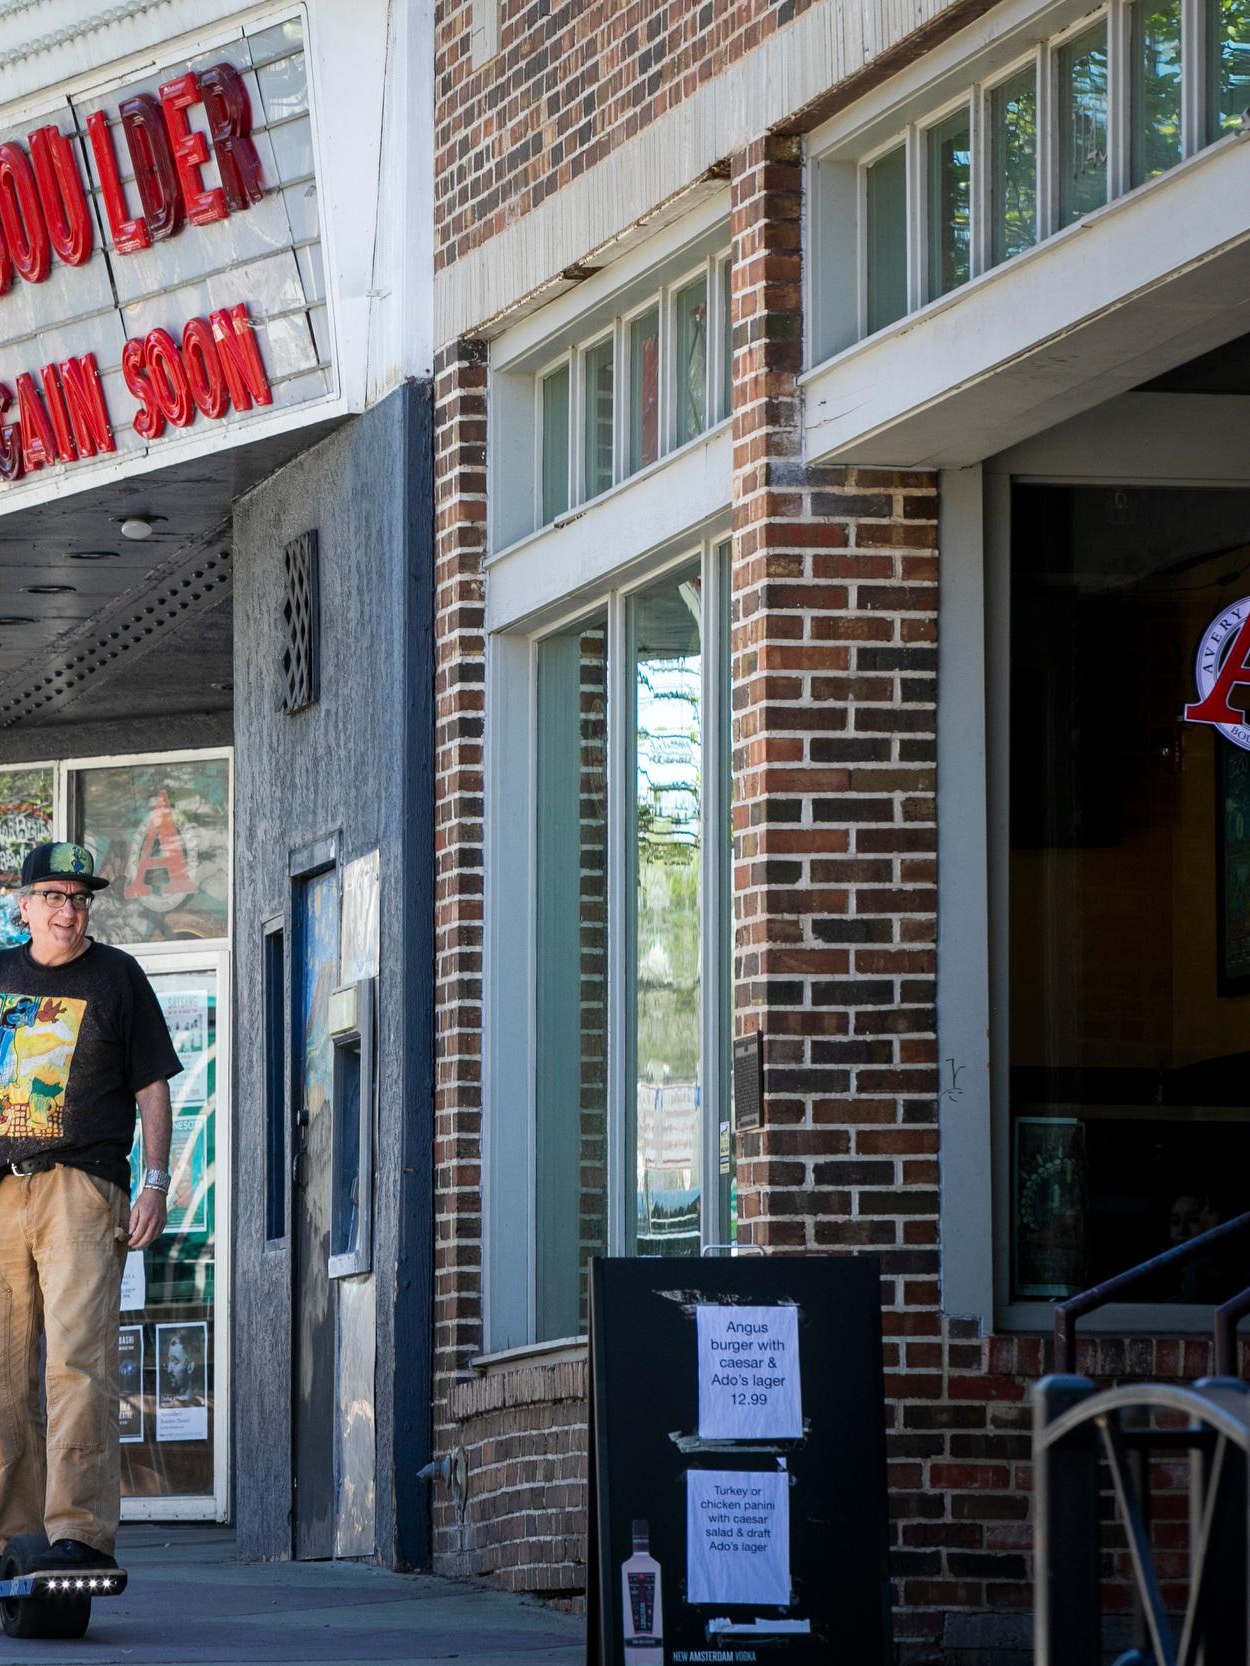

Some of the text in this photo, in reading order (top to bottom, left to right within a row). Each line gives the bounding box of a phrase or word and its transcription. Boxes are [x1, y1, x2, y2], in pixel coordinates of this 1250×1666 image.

[121, 302, 273, 440] SOON
[1202, 608, 1243, 674] AVERY
[726, 1321, 768, 1336] Angus
[711, 1339, 785, 1354] burger with
[719, 1357, 777, 1369] caesar &
[711, 1374, 786, 1389] Ado's lager
[730, 1394, 768, 1406] 12.99
[714, 1486, 761, 1498] Turkey or
[701, 1500, 775, 1512] chicken panini
[709, 1514, 768, 1525] with caesar
[705, 1527, 771, 1539] salad & draft
[709, 1541, 767, 1554] Ado's lager
[673, 1652, 757, 1663] NEW AMSTERDAM VODKA
